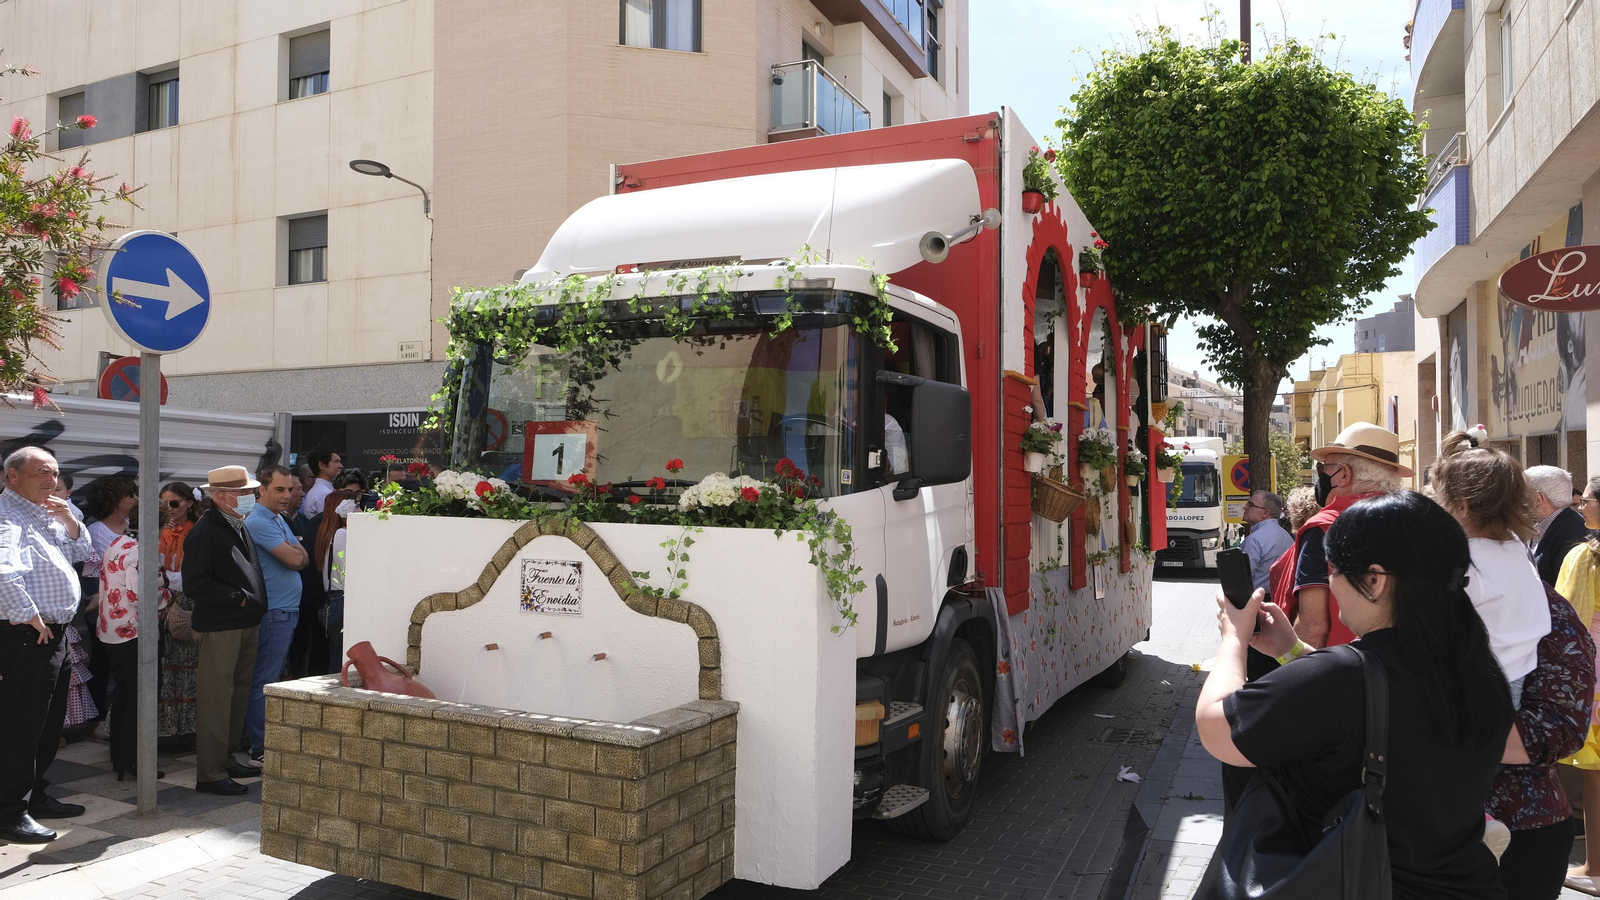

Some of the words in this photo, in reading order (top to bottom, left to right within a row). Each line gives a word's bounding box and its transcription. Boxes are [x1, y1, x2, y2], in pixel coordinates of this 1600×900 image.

[681, 259, 730, 268] Dometic
[389, 413, 420, 427] ISDIN
[552, 442, 565, 475] 1
[526, 567, 565, 584] Fuente
[565, 573, 577, 586] la
[532, 588, 579, 606] Envidia
